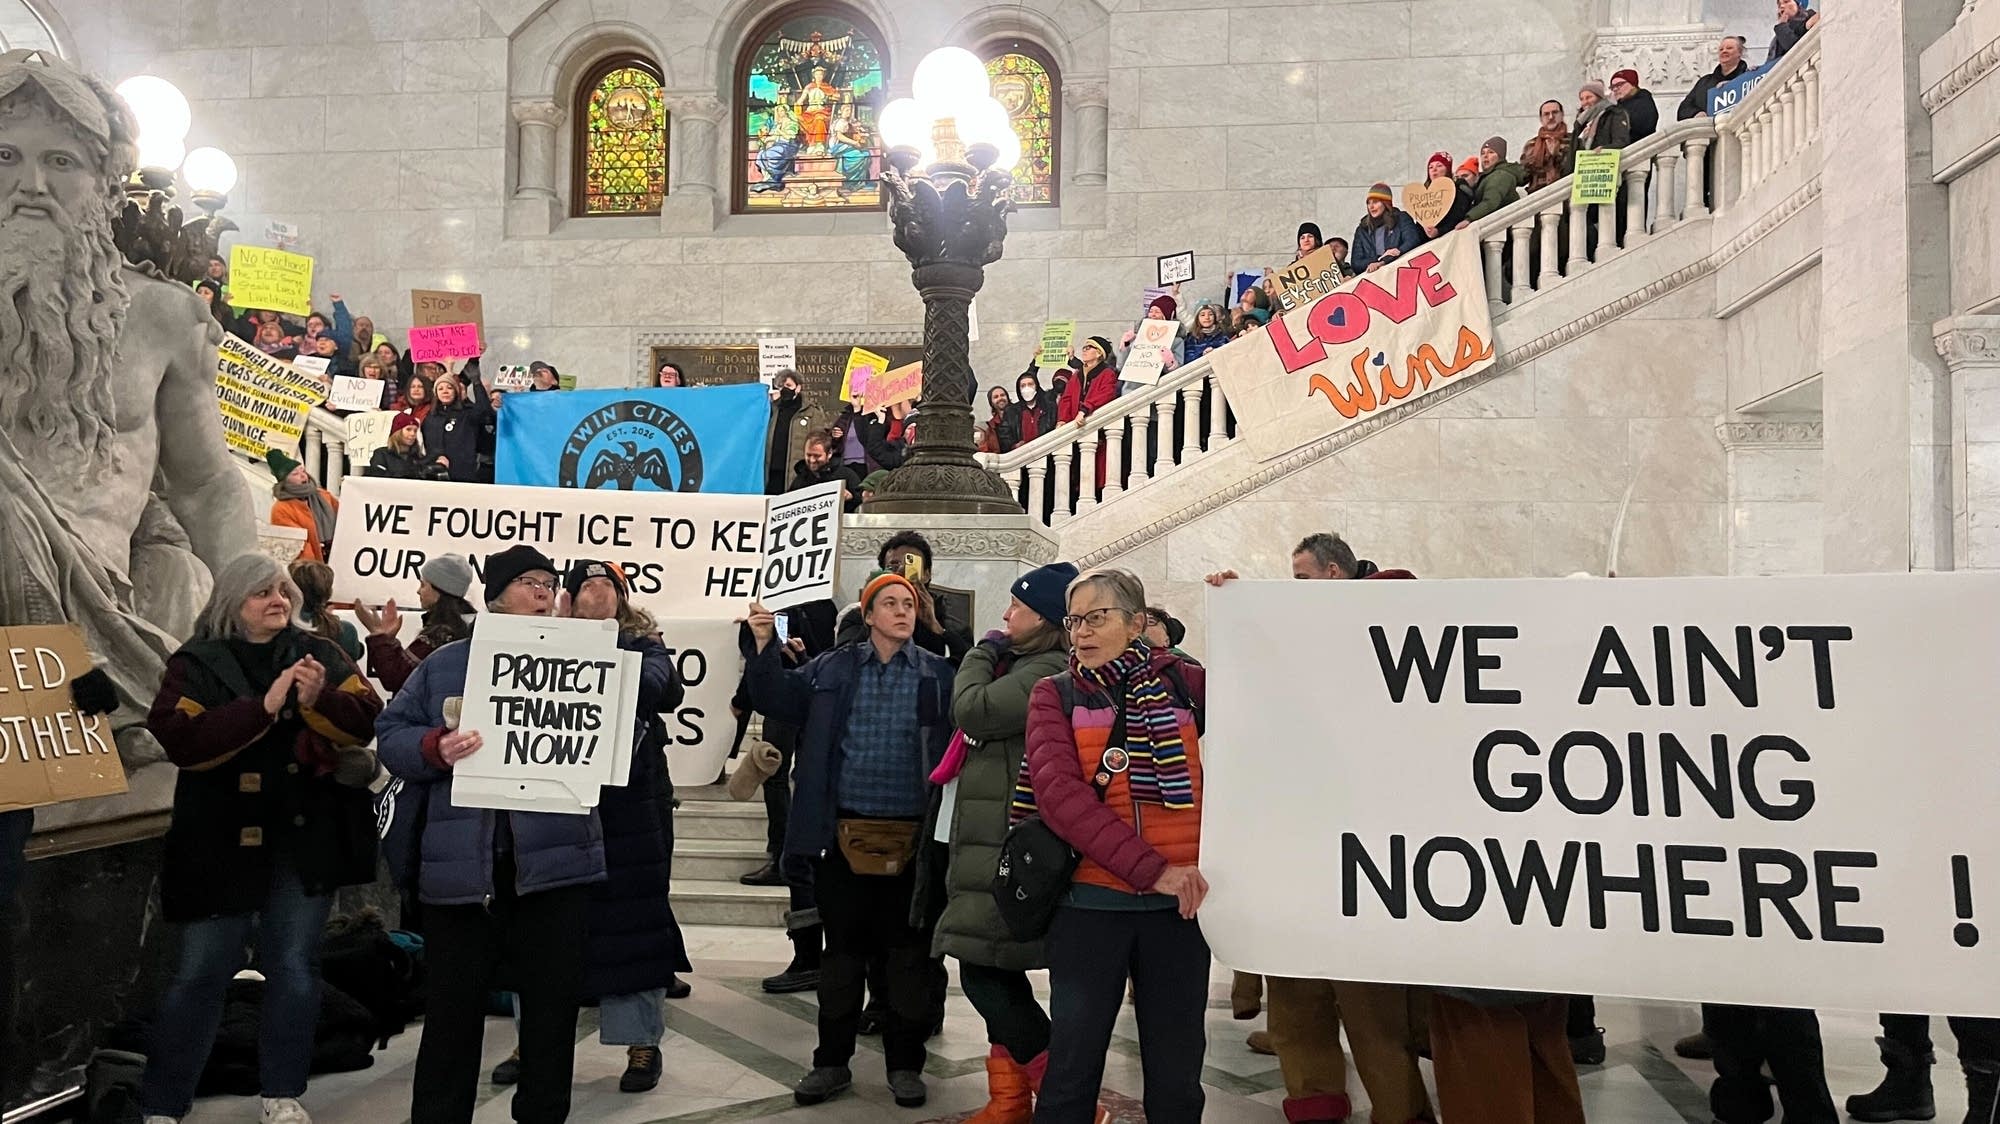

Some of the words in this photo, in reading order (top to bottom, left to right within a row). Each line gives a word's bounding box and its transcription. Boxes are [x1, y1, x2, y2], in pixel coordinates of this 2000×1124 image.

[1714, 90, 1736, 112] NO
[1415, 208, 1442, 221] NOW
[240, 249, 258, 263] No
[1280, 265, 1310, 289] NO
[420, 296, 453, 310] STOP
[1266, 250, 1457, 374] LOVE
[419, 328, 445, 340] WHAT
[450, 326, 465, 337] ARE
[416, 349, 443, 360] GOING
[700, 355, 715, 364] THE
[716, 364, 739, 373] CITY
[347, 379, 367, 391] NO
[1308, 325, 1494, 419] Wins
[246, 425, 268, 442] ICE
[566, 407, 616, 455] TWIN
[633, 404, 694, 455] CITIES
[606, 427, 627, 441] EST.
[770, 504, 818, 525] NEIGHBORS
[818, 500, 835, 511] SAY
[365, 503, 413, 534] WE
[427, 507, 562, 543] FOUGHT
[578, 513, 634, 546] ICE
[650, 517, 696, 550] TO
[711, 520, 765, 554] KE
[768, 512, 829, 556] ICE
[354, 547, 427, 581] OUR
[764, 548, 833, 590] OUT!
[491, 653, 616, 696] PROTECT
[1369, 625, 1522, 705] WE
[1577, 625, 1853, 710] AIN'T
[489, 695, 602, 731] TENANTS
[503, 730, 599, 766] NOW!
[1472, 729, 1816, 822] GOING
[1341, 832, 1885, 944] NOWHERE
[1951, 854, 1980, 948] !
